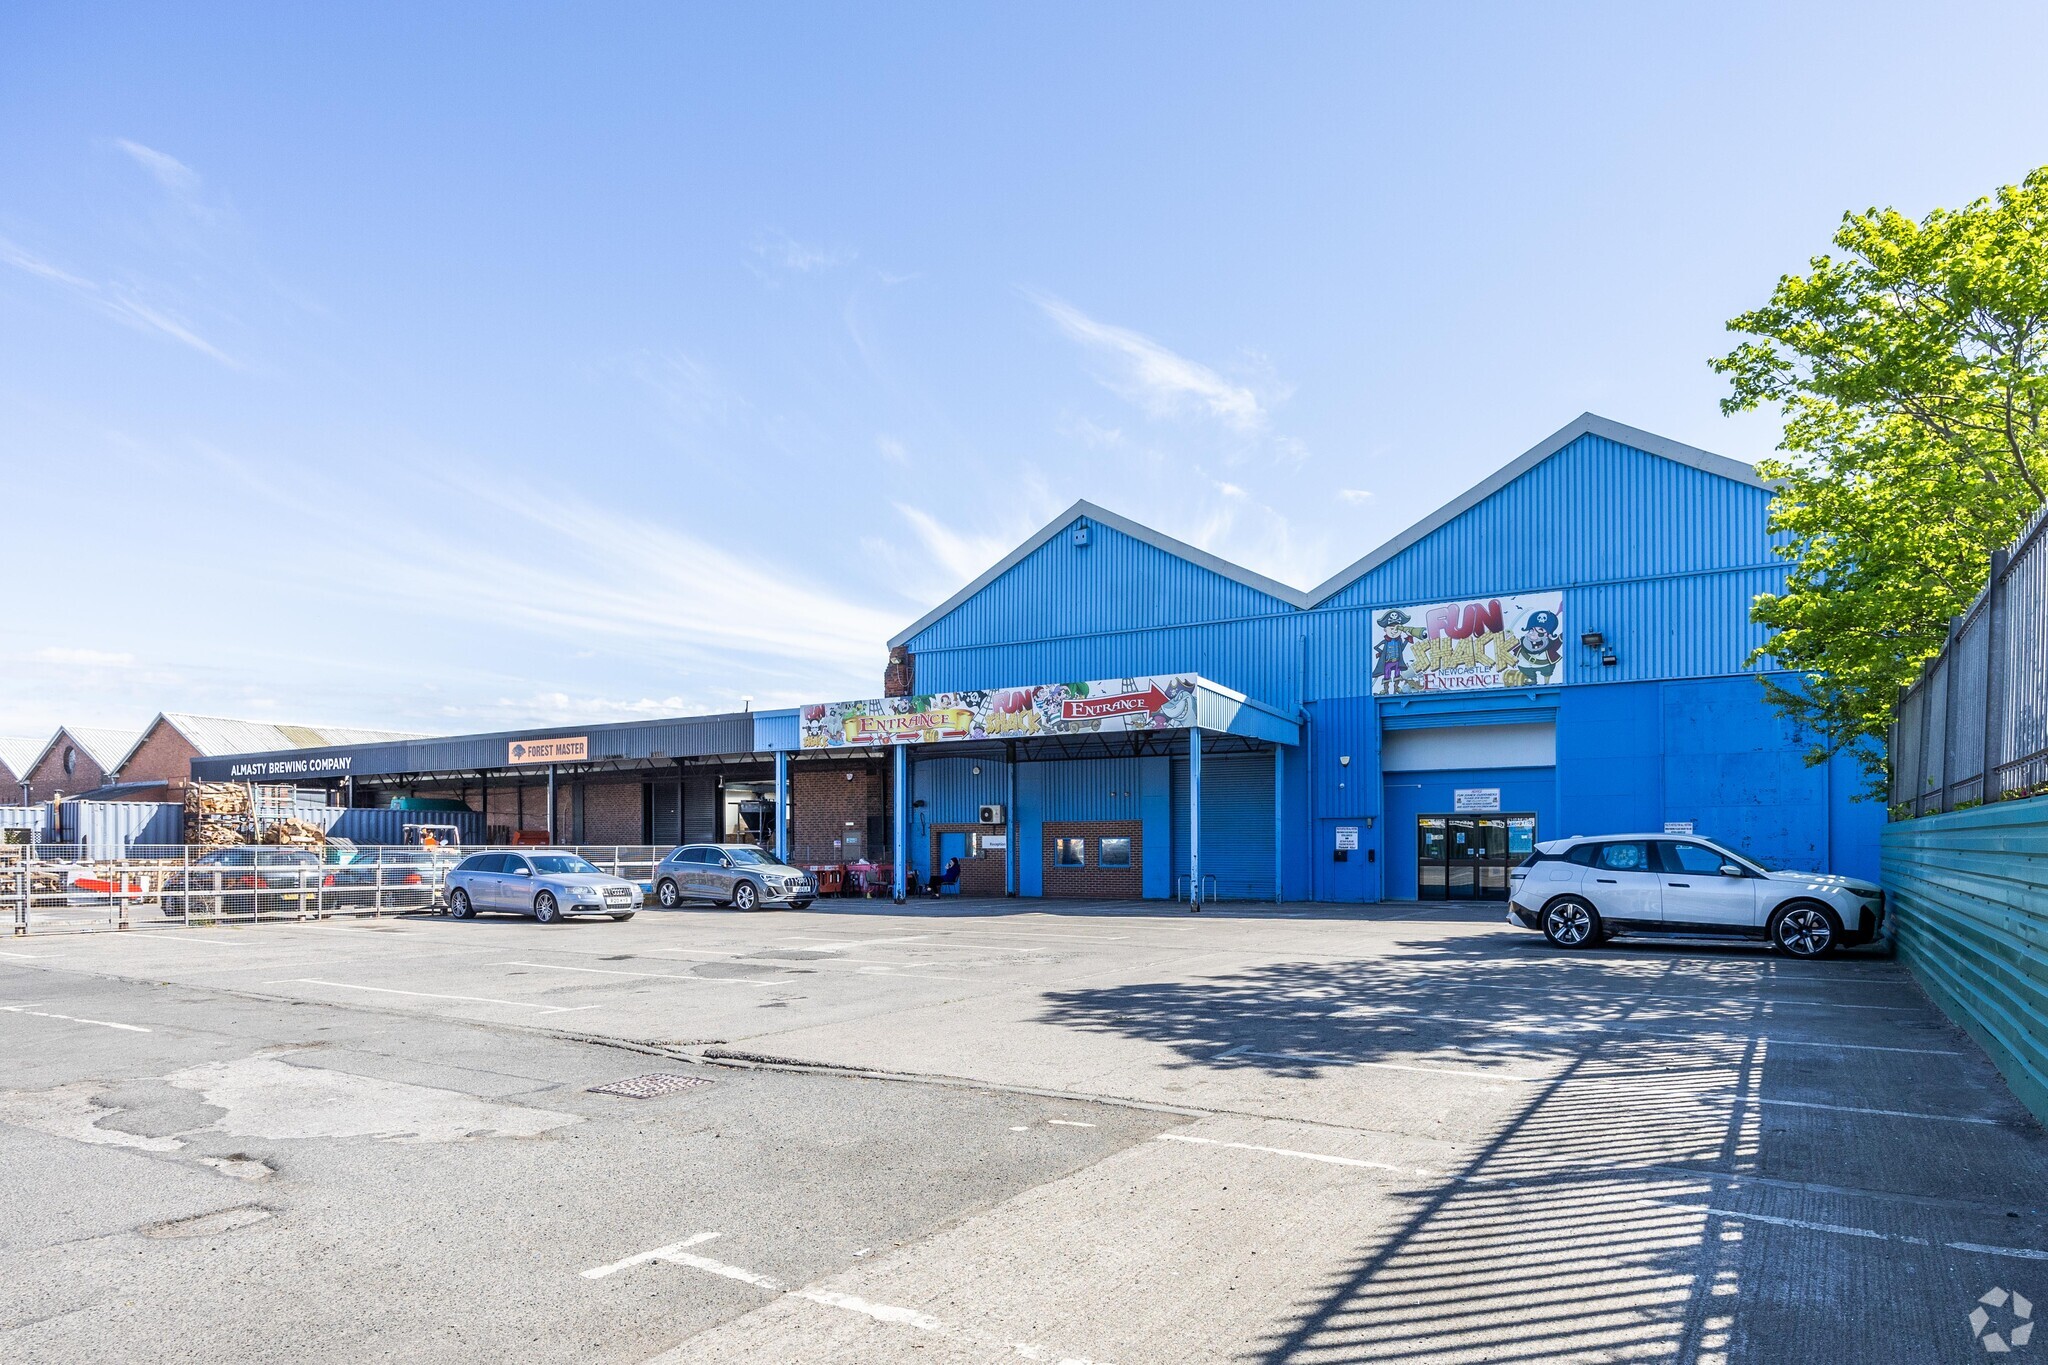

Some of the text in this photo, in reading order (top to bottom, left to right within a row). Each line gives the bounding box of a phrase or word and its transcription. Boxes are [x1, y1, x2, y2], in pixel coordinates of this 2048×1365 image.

[1426, 598, 1504, 641] FUN
[1410, 630, 1521, 673] SHACK
[1438, 666, 1491, 676] NEWCASTLE
[1423, 673, 1500, 691] ENTRANCE
[993, 688, 1034, 714] FUN
[1071, 699, 1146, 717] ENTRANCE
[859, 713, 951, 732] ENTRANCE
[984, 709, 1042, 735] SHACK
[527, 742, 584, 758] FOREST MASTER
[231, 757, 352, 776] ALMASTY BREWING COMPANY
